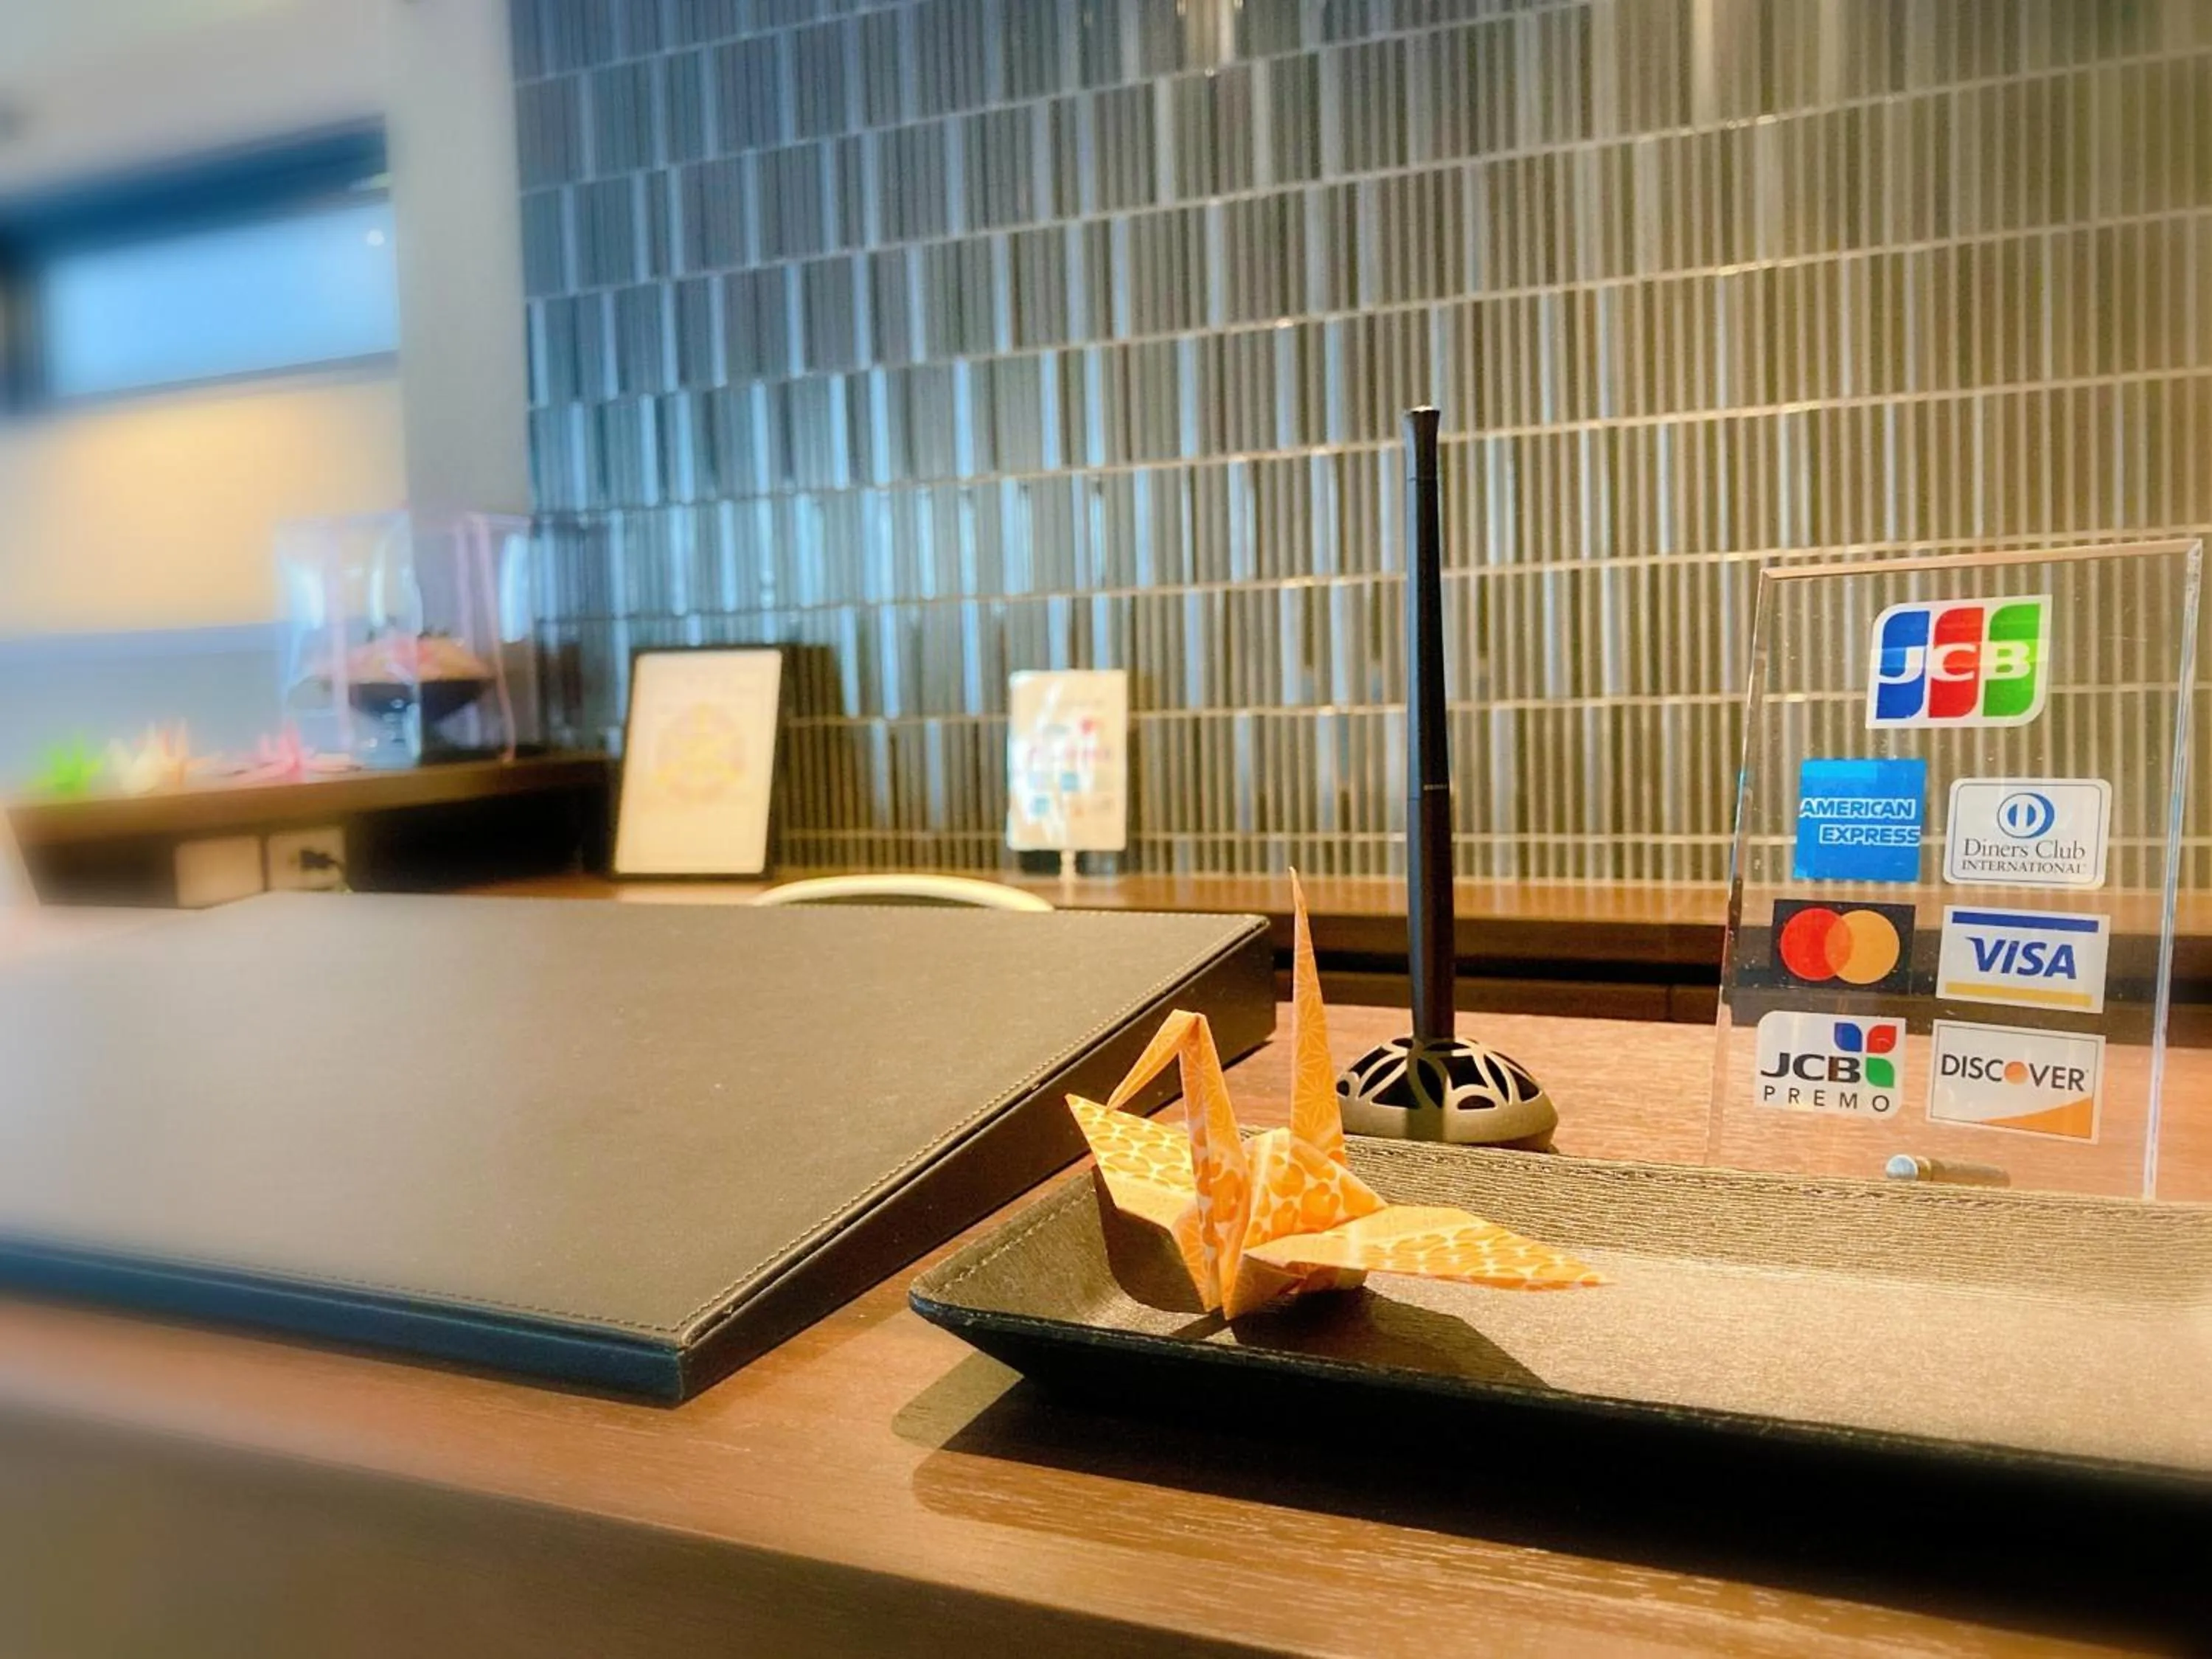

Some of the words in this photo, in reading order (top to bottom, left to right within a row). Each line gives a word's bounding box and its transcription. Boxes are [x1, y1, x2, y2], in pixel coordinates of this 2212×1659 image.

[1879, 643, 2031, 683] JCB
[1799, 798, 1916, 818] AMERICAN
[1820, 824, 1920, 845] EXPRESS
[1964, 838, 2028, 858] Diners
[2036, 839, 2085, 860] Club
[1961, 860, 2084, 874] INTERNATIONAL
[1966, 937, 2077, 979] VISA
[1760, 1053, 1861, 1083] JCB
[1941, 1054, 2085, 1092] DISCOVER
[1763, 1085, 1890, 1113] PREMO
